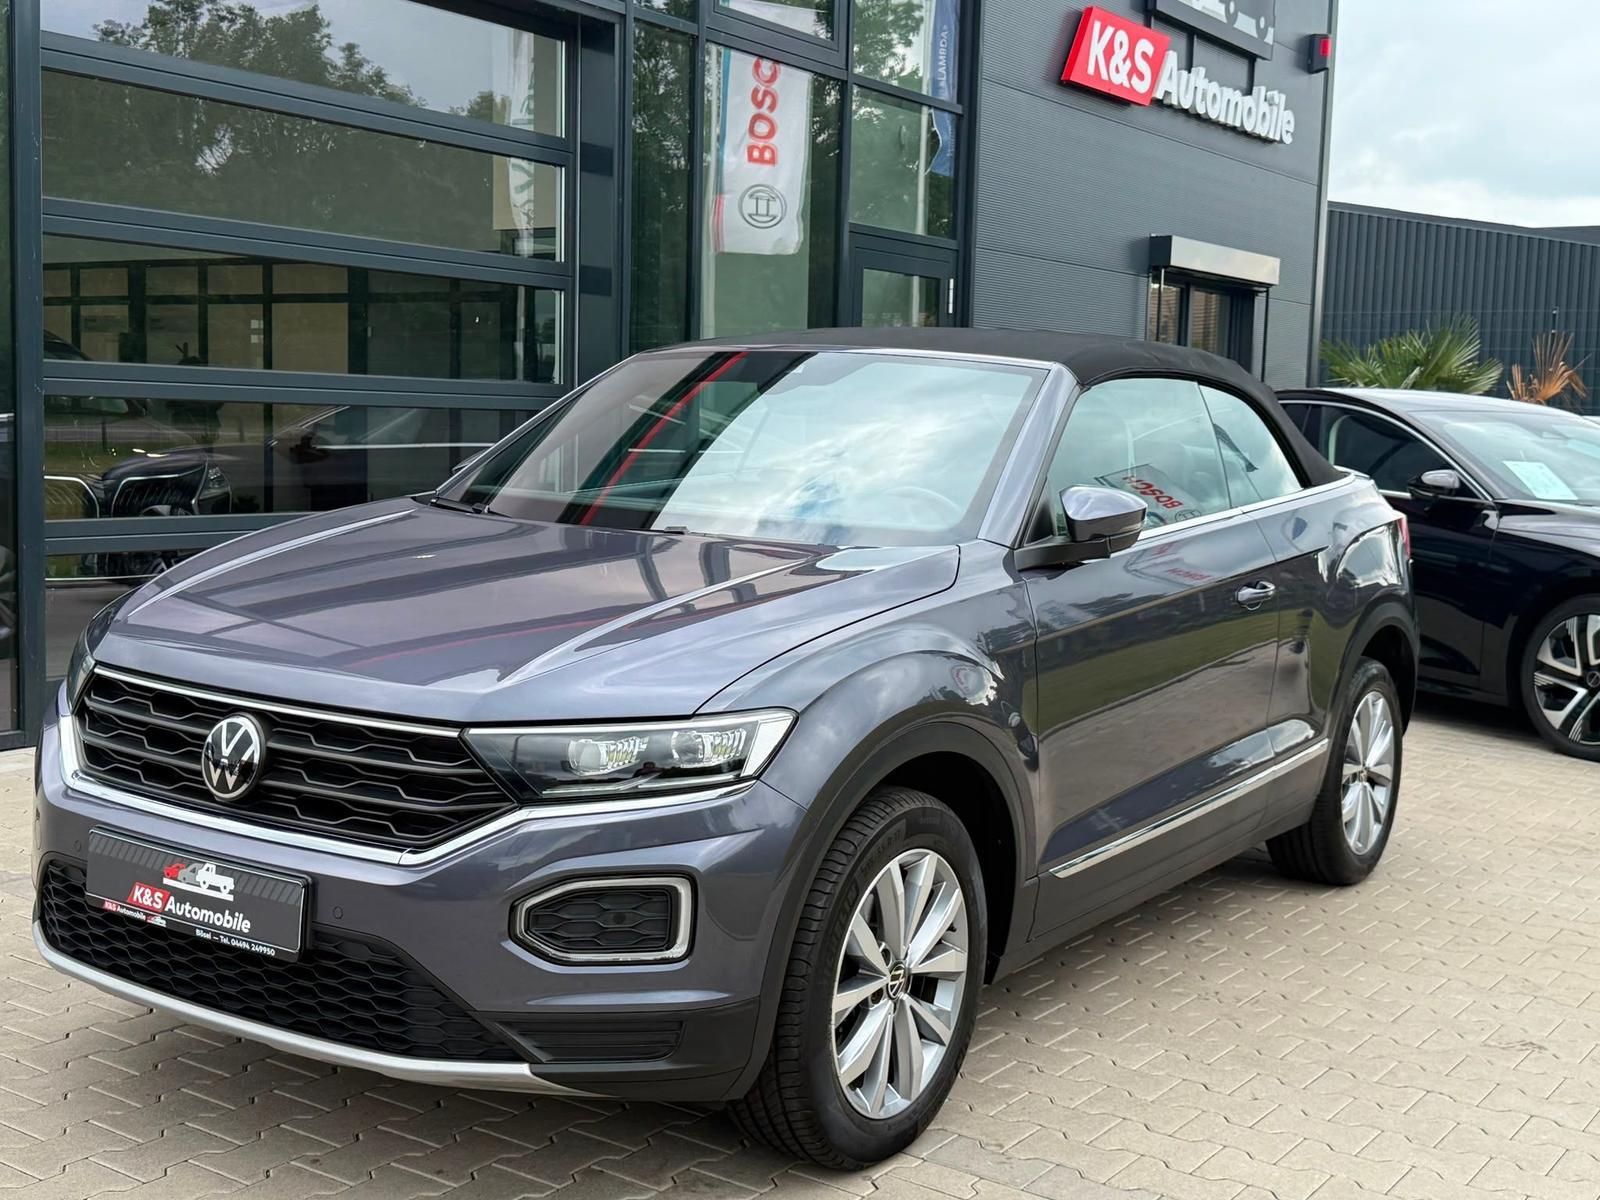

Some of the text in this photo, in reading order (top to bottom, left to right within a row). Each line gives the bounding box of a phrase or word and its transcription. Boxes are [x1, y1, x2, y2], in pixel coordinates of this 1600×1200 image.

[1087, 20, 1296, 145] K&S Automobile
[747, 56, 780, 167] BOSC
[117, 905, 146, 921] Automobile
[132, 886, 251, 933] K&S Automobile
[231, 938, 250, 950] 04494
[251, 943, 276, 956] 249950
